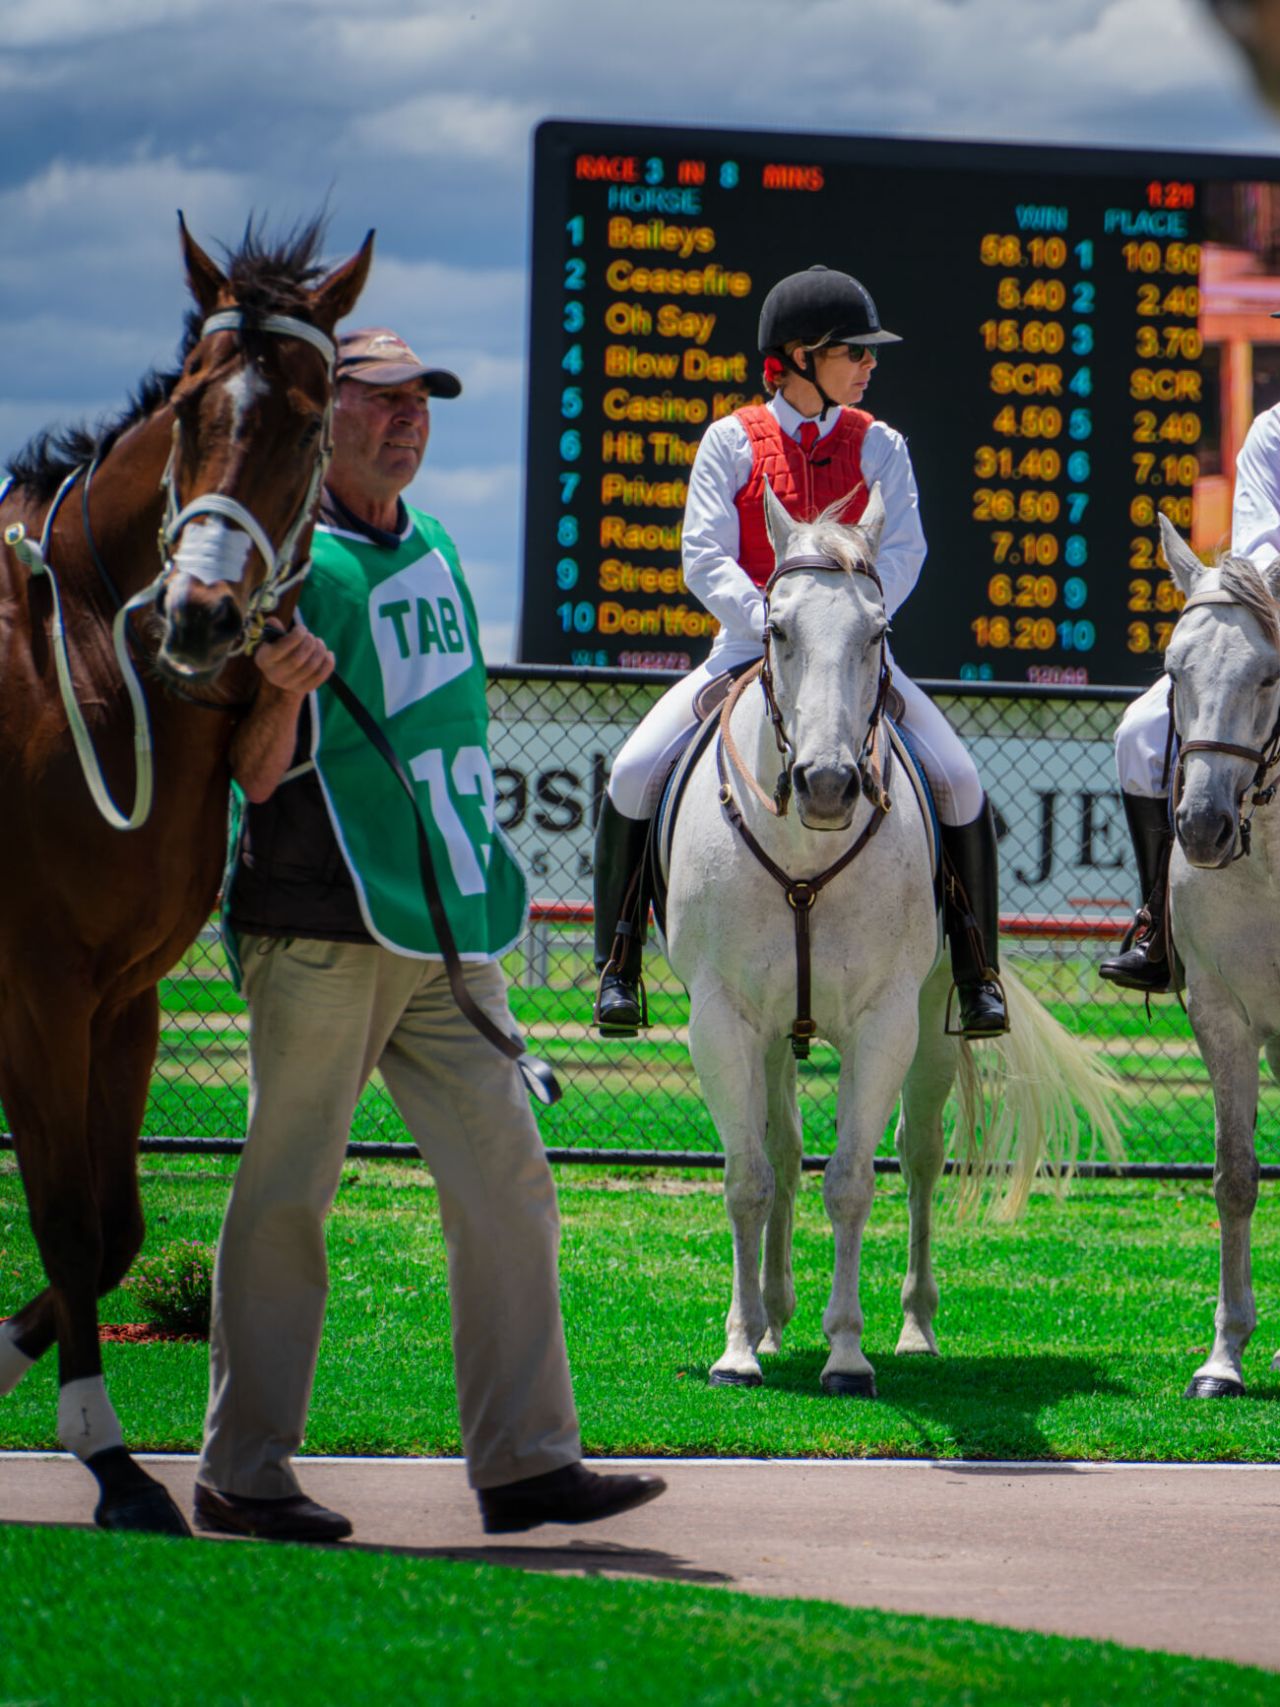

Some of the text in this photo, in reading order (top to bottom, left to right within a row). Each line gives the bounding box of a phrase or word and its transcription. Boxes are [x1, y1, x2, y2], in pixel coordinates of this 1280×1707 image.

[576, 155, 824, 191] RACE 3 IN 8 MINS
[608, 186, 701, 215] HORSE
[1015, 205, 1068, 231] WIN
[564, 216, 716, 258] 1 Baileys
[1104, 208, 1188, 238] PLACE
[1074, 239, 1093, 270] 1
[564, 258, 751, 298] 2 Ceasefire
[1071, 281, 1095, 314] 2
[1136, 284, 1201, 317] 2.40
[563, 301, 716, 344] 3 Oh Say
[1071, 323, 1093, 356] 3
[1136, 326, 1203, 360] 3.70
[562, 344, 747, 383] 4 Blow Dart
[990, 361, 1202, 402] SCR 4 SCR
[561, 387, 583, 419] 5
[603, 387, 708, 424] Casino
[1068, 408, 1092, 440] 5
[1133, 410, 1201, 444] 2.40
[559, 429, 582, 462] 6
[602, 430, 644, 463] Hit
[974, 446, 1200, 486] 31.40 6 7.10
[559, 472, 689, 508] 7 Privat
[1066, 493, 1089, 524] 7
[557, 515, 579, 547] 8
[992, 531, 1059, 566] 7.10
[1065, 535, 1087, 567] 8
[556, 558, 579, 590] 9
[1063, 577, 1088, 609] 9
[378, 597, 465, 660] TAB
[556, 601, 595, 633] 10
[1057, 620, 1096, 651] 10
